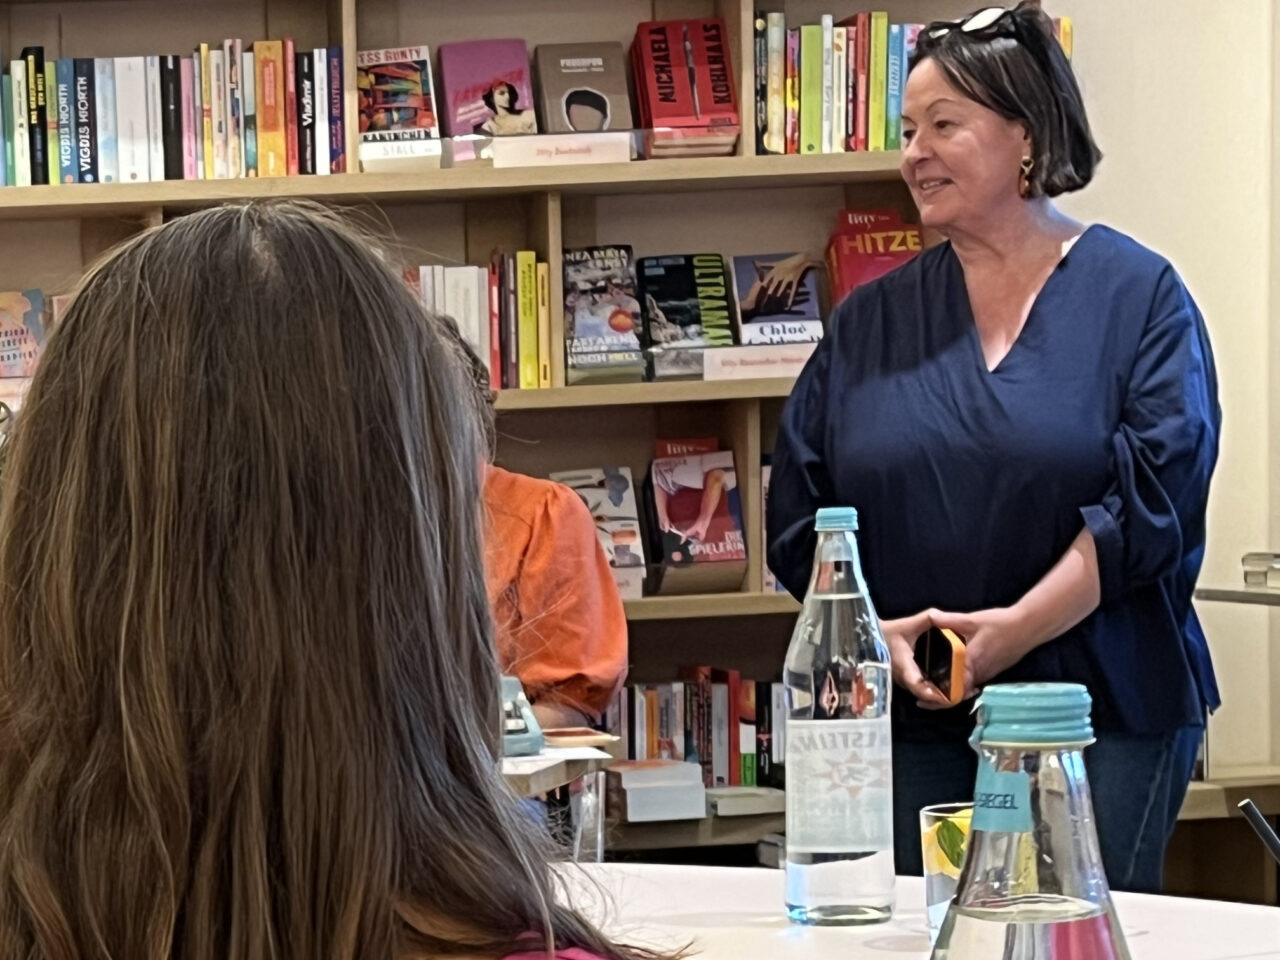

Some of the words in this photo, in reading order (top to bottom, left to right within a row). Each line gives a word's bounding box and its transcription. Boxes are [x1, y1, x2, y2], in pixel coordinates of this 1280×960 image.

[648, 26, 677, 103] MICHAELA
[703, 24, 732, 105] KOHLHAAS
[77, 76, 89, 122] HJORTH
[302, 79, 313, 127] Vladimir
[59, 127, 72, 167] VIGDIS
[78, 126, 91, 171] VIGDIS
[841, 230, 922, 255] HITZE
[759, 323, 807, 336] Chloé
